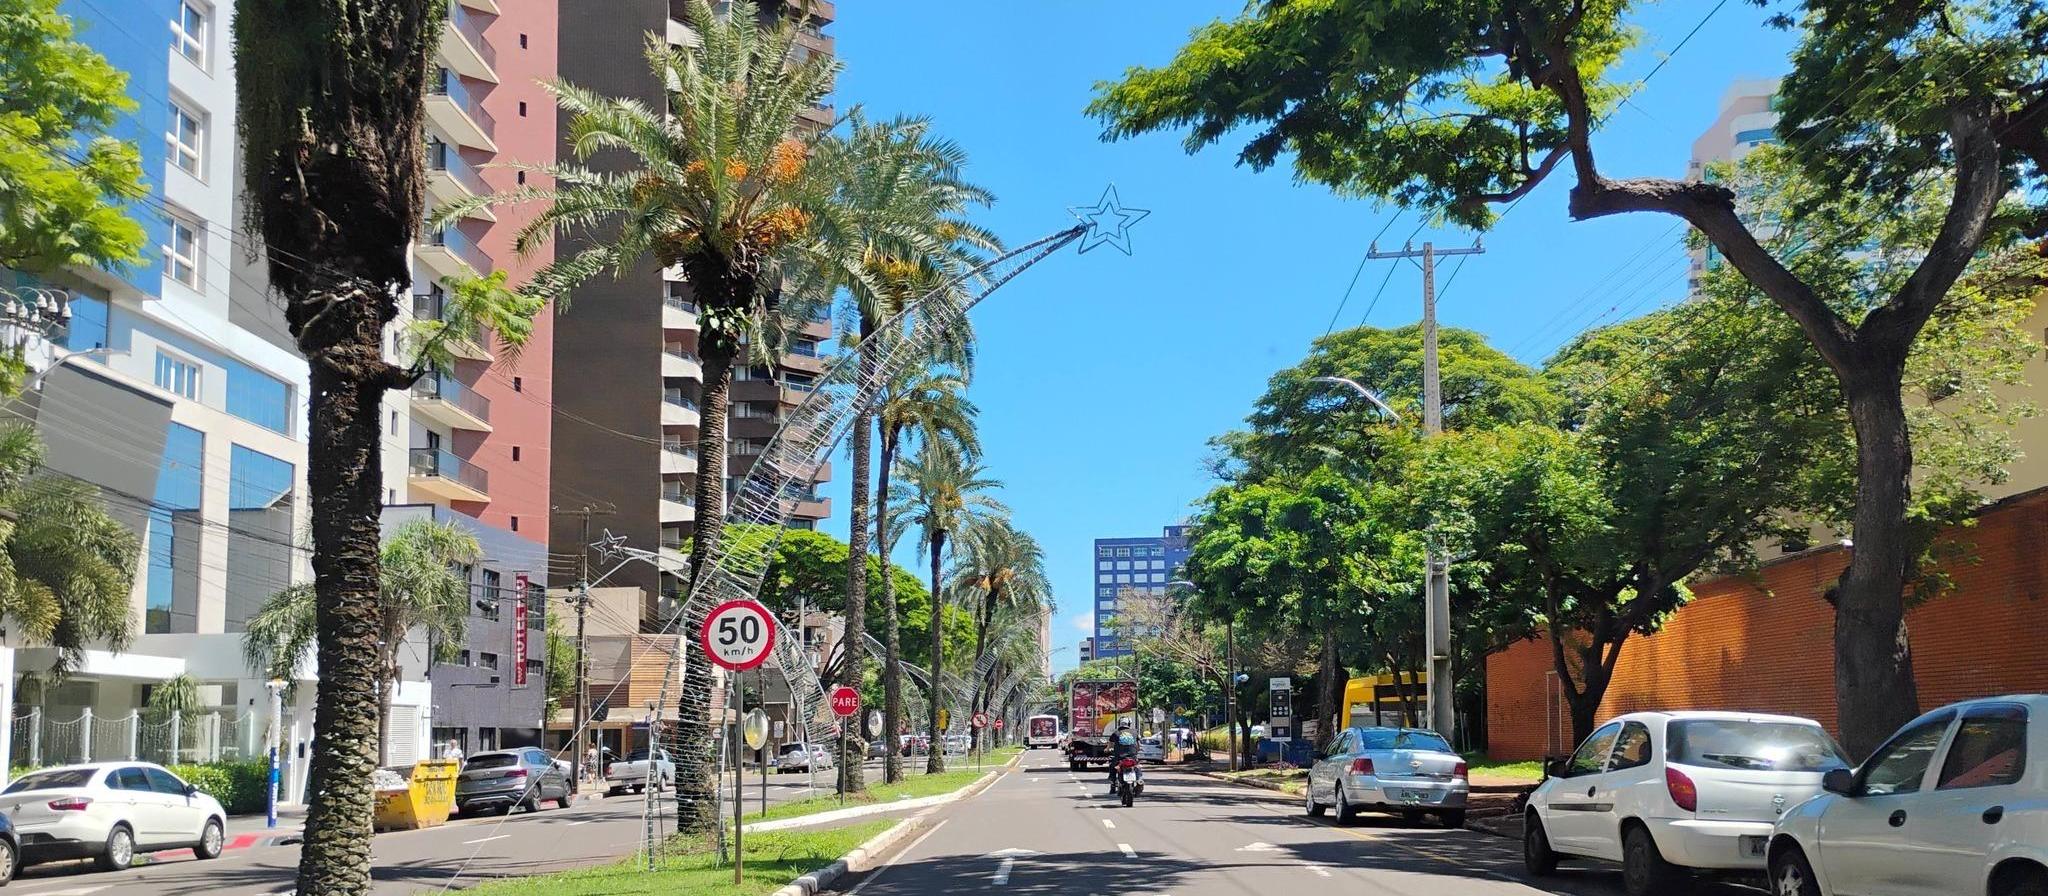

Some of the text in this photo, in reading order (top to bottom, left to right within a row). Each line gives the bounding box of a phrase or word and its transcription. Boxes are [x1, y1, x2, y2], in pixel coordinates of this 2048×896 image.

[516, 612, 526, 663] HOTEL
[718, 615, 760, 645] 50
[723, 646, 754, 656] km/h
[832, 697, 857, 706] PARE
